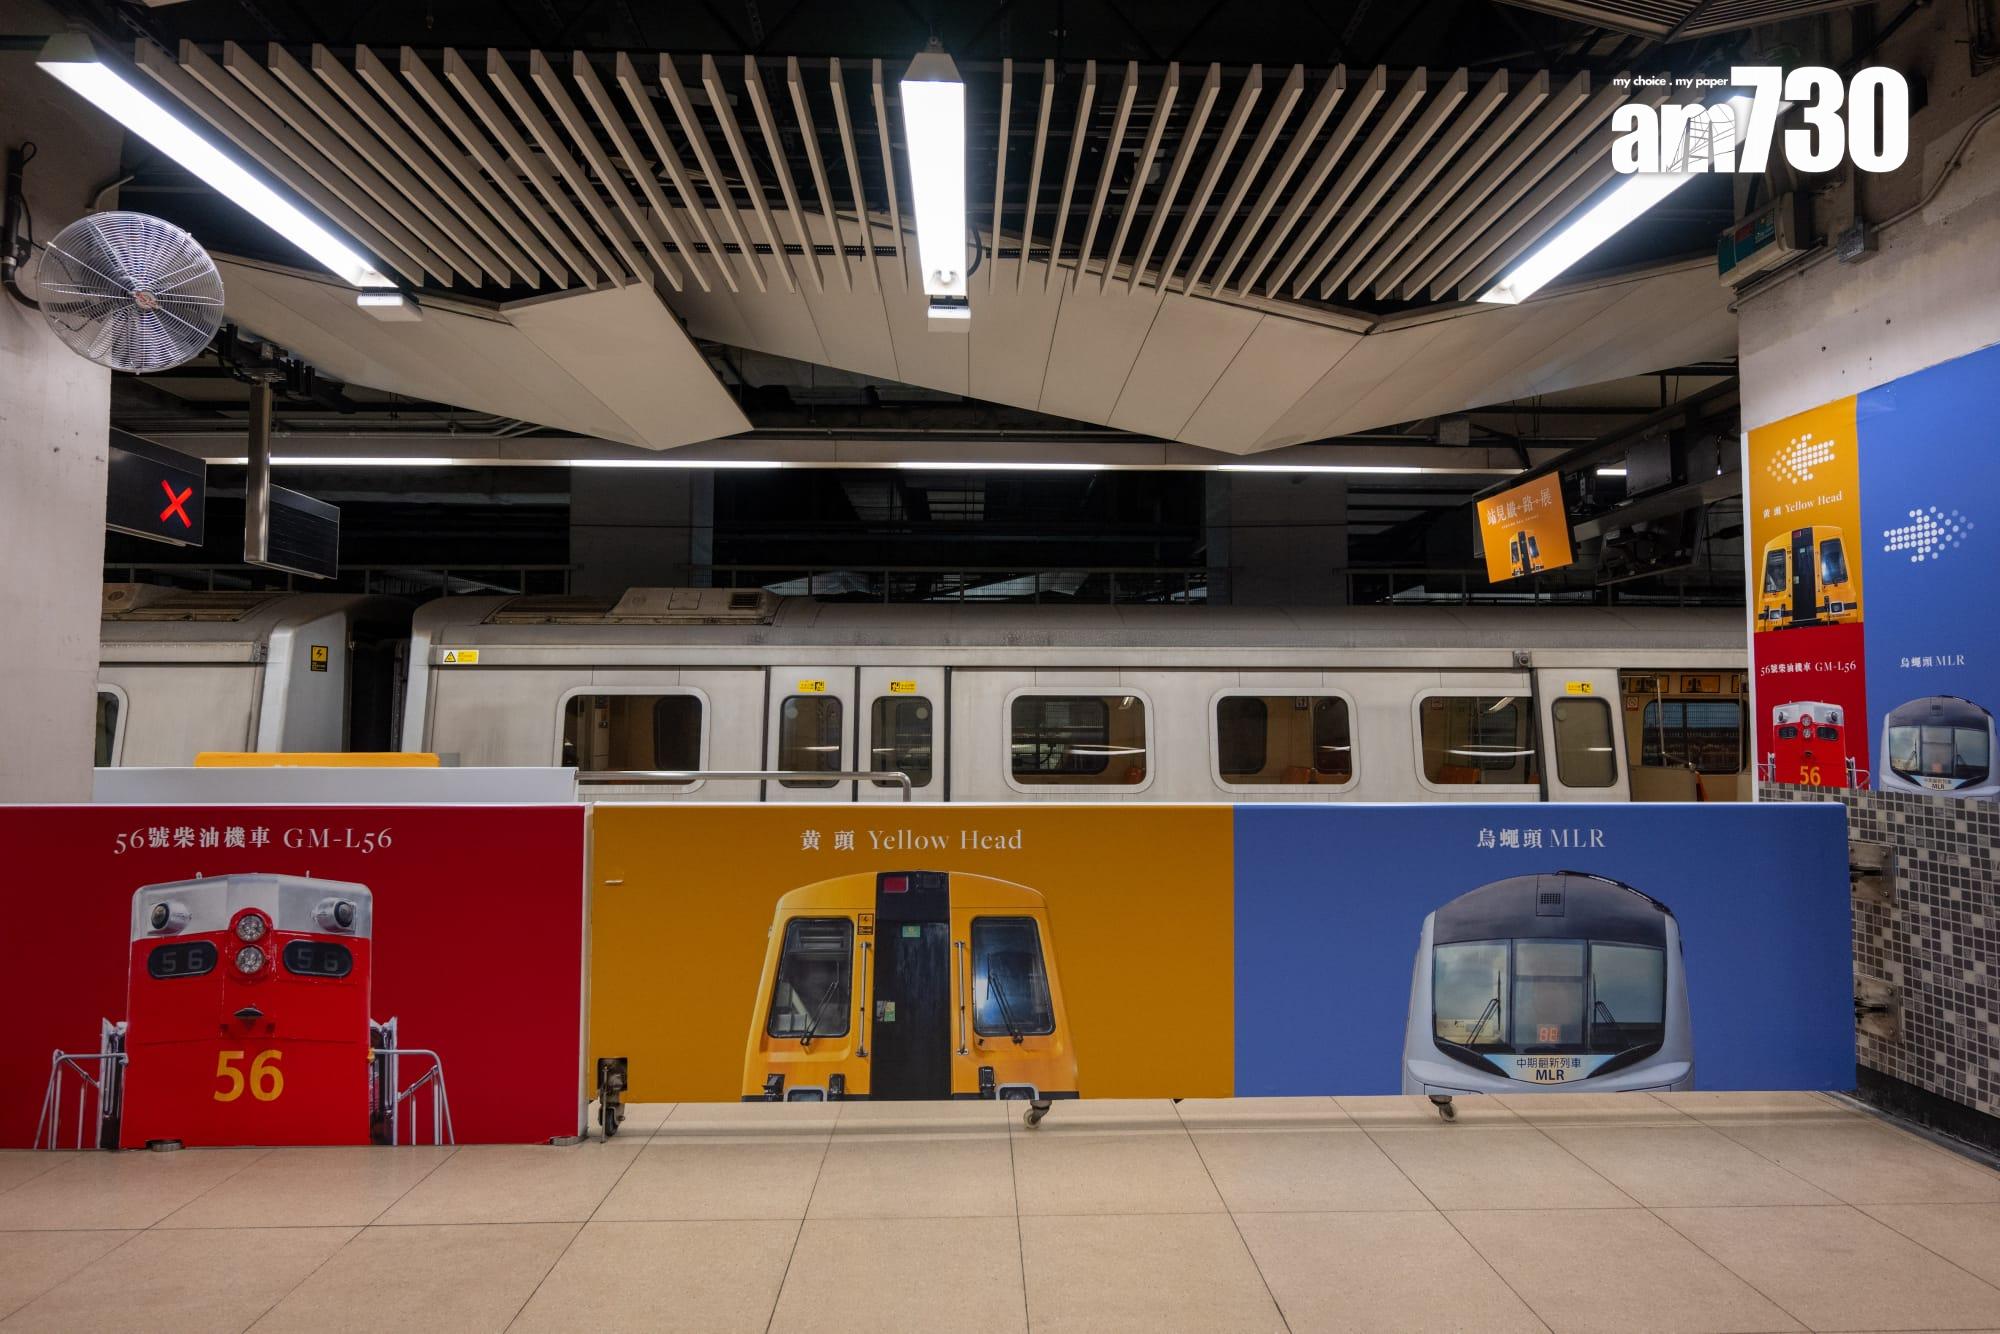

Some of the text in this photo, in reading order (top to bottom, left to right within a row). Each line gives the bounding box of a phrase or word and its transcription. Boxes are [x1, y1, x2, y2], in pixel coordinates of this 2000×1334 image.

[1785, 501, 1814, 513] Yellow
[1818, 490, 1843, 506] Head
[1815, 660, 1857, 673] GM-L56
[1935, 655, 1965, 666] MLR
[1800, 765, 1821, 786] 56
[114, 826, 393, 854] 56號柴油機車 GM-L56
[868, 830, 949, 850] Yellow
[961, 829, 1022, 850] Head
[1550, 828, 1606, 848] MLR
[213, 1049, 284, 1102] 56
[1535, 1069, 1565, 1081] MLR
